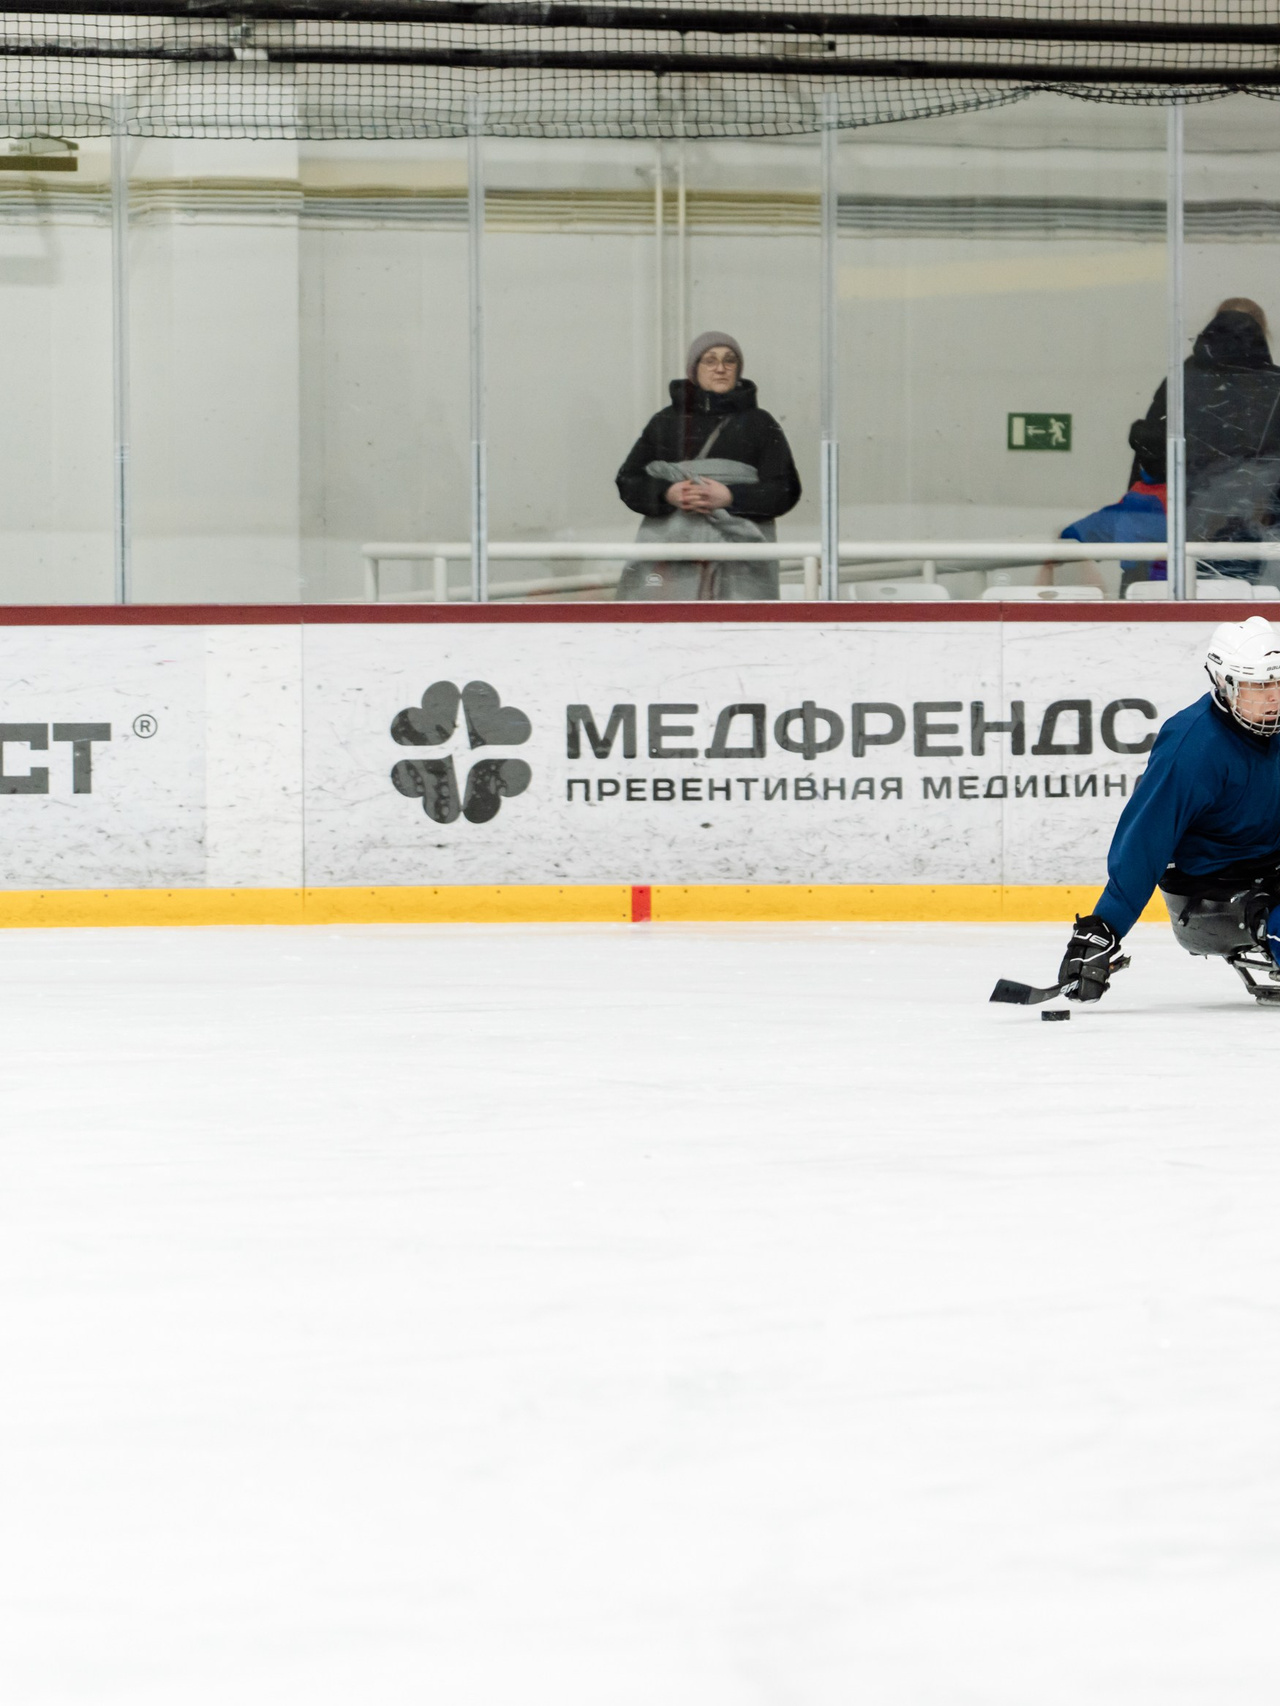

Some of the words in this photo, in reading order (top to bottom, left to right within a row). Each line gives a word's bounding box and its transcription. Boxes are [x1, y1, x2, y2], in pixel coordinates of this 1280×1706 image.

[566, 698, 1158, 760] МЕДФРЕНДС
[567, 777, 902, 801] ПРЕВЕНТИВНАЯ
[922, 773, 1144, 799] МЕДИЦИН
